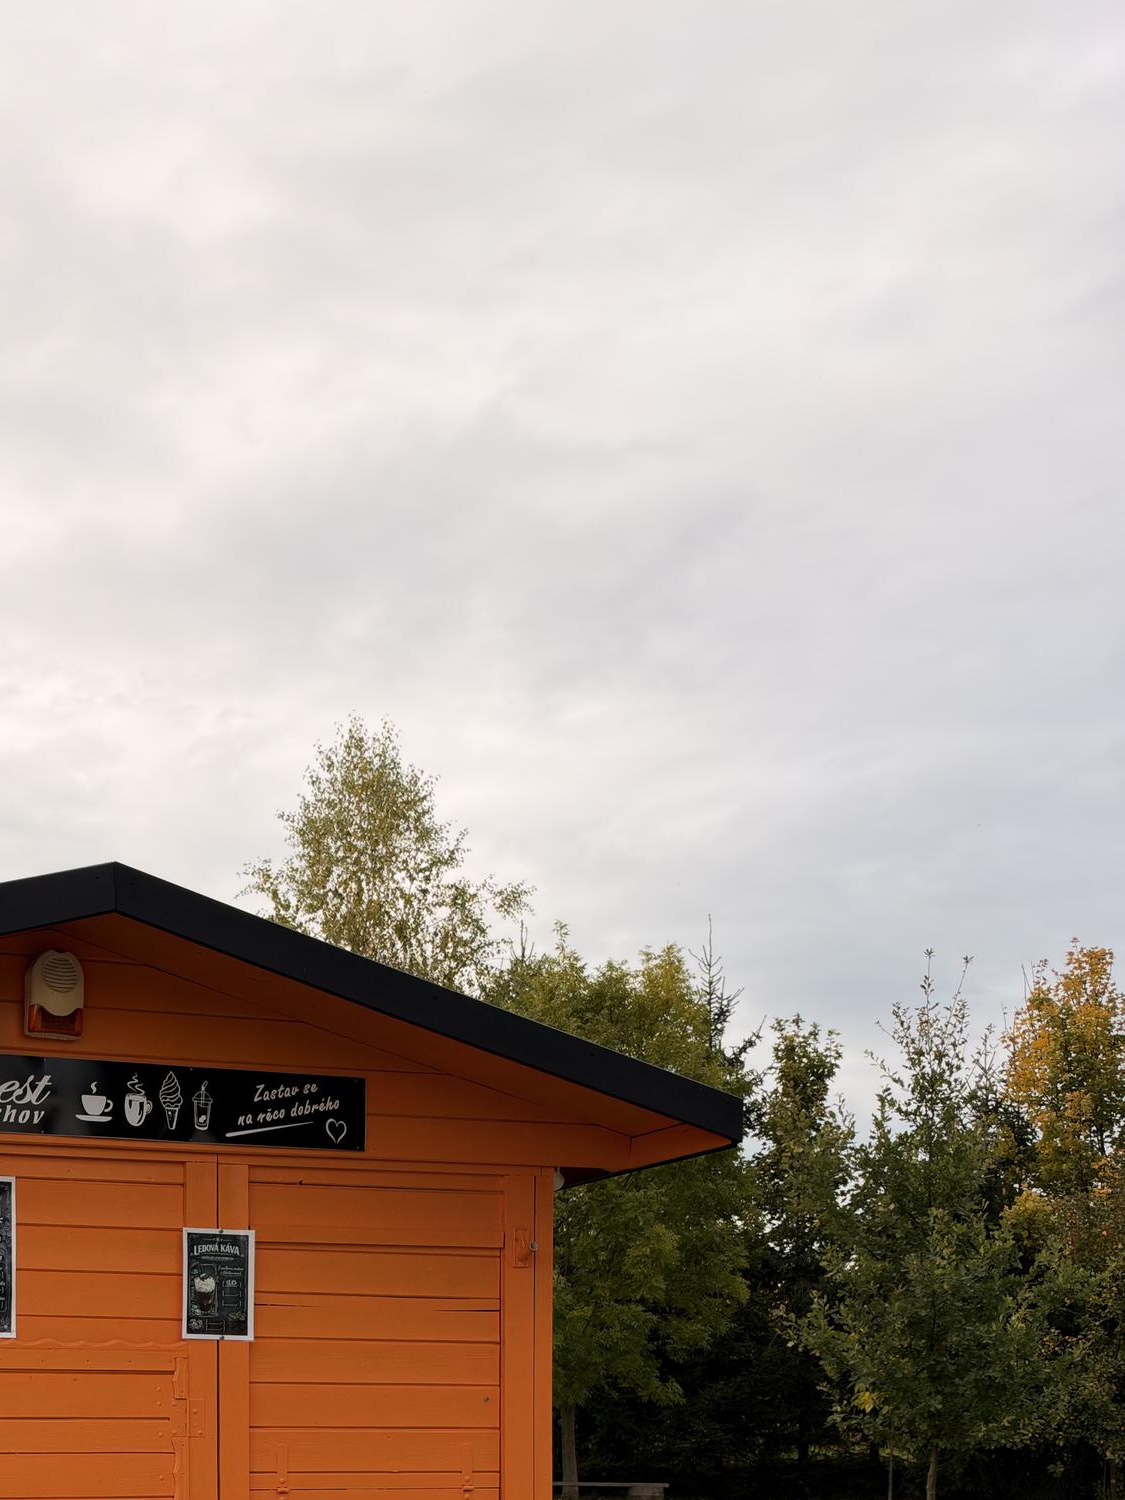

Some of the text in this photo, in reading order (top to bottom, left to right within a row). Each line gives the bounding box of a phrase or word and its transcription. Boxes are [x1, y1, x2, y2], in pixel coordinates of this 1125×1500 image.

[253, 1083, 318, 1102] Zastav se
[237, 1096, 340, 1126] na něco dobrého
[193, 1241, 240, 1256] LEDOVÁ KÁVA
